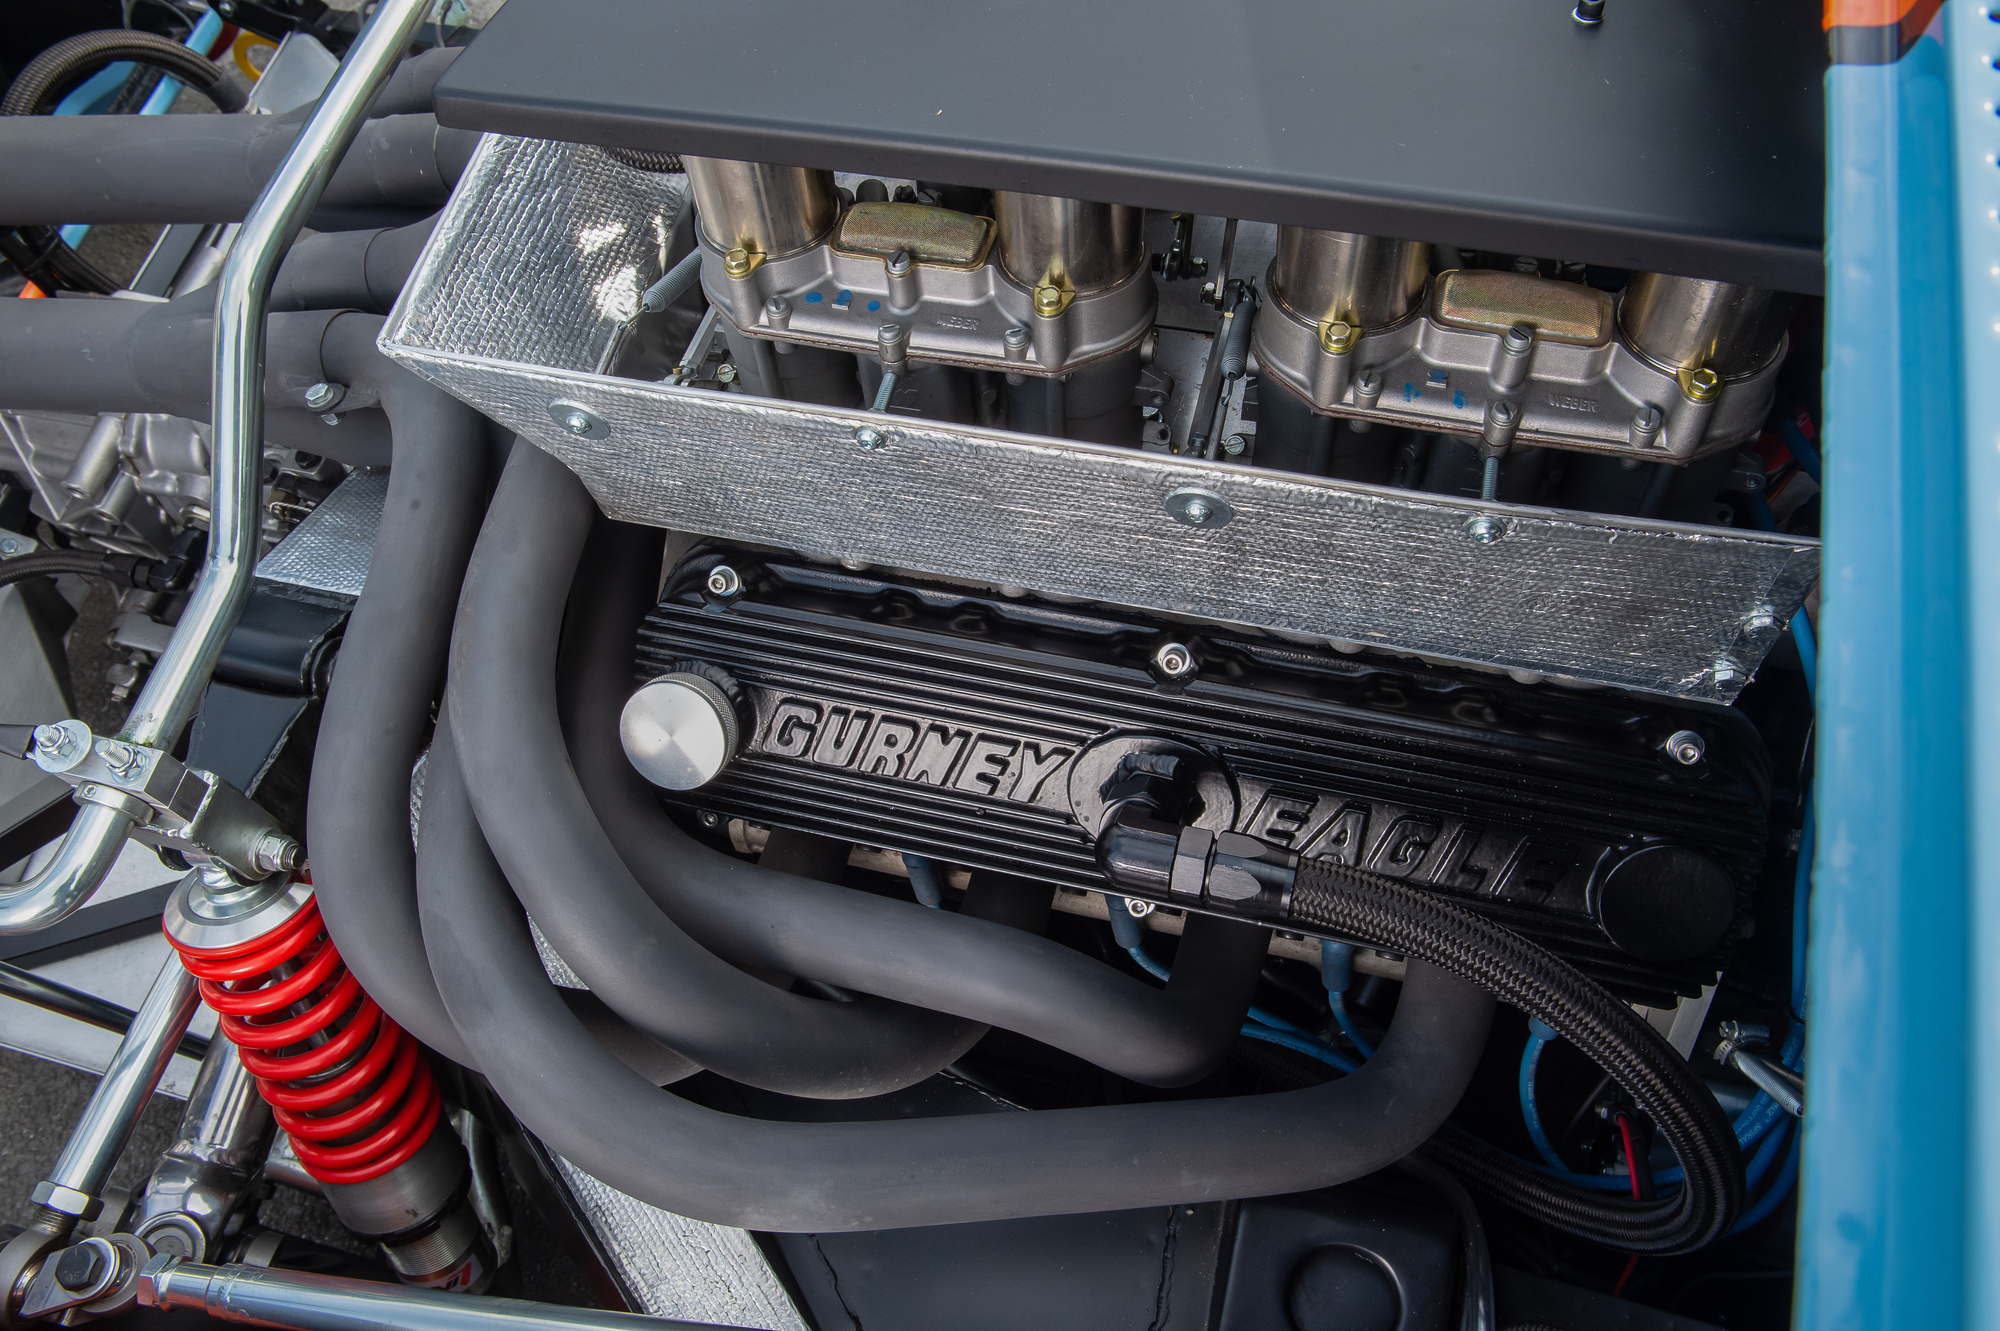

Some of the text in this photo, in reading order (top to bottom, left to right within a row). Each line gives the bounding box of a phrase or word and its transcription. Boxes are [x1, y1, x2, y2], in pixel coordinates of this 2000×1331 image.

[935, 312, 981, 331] WEBER
[1548, 392, 1599, 413] WEBER
[762, 701, 1581, 903] GURNEY EAGLE
[1738, 1122, 1763, 1145] SPIRAL
